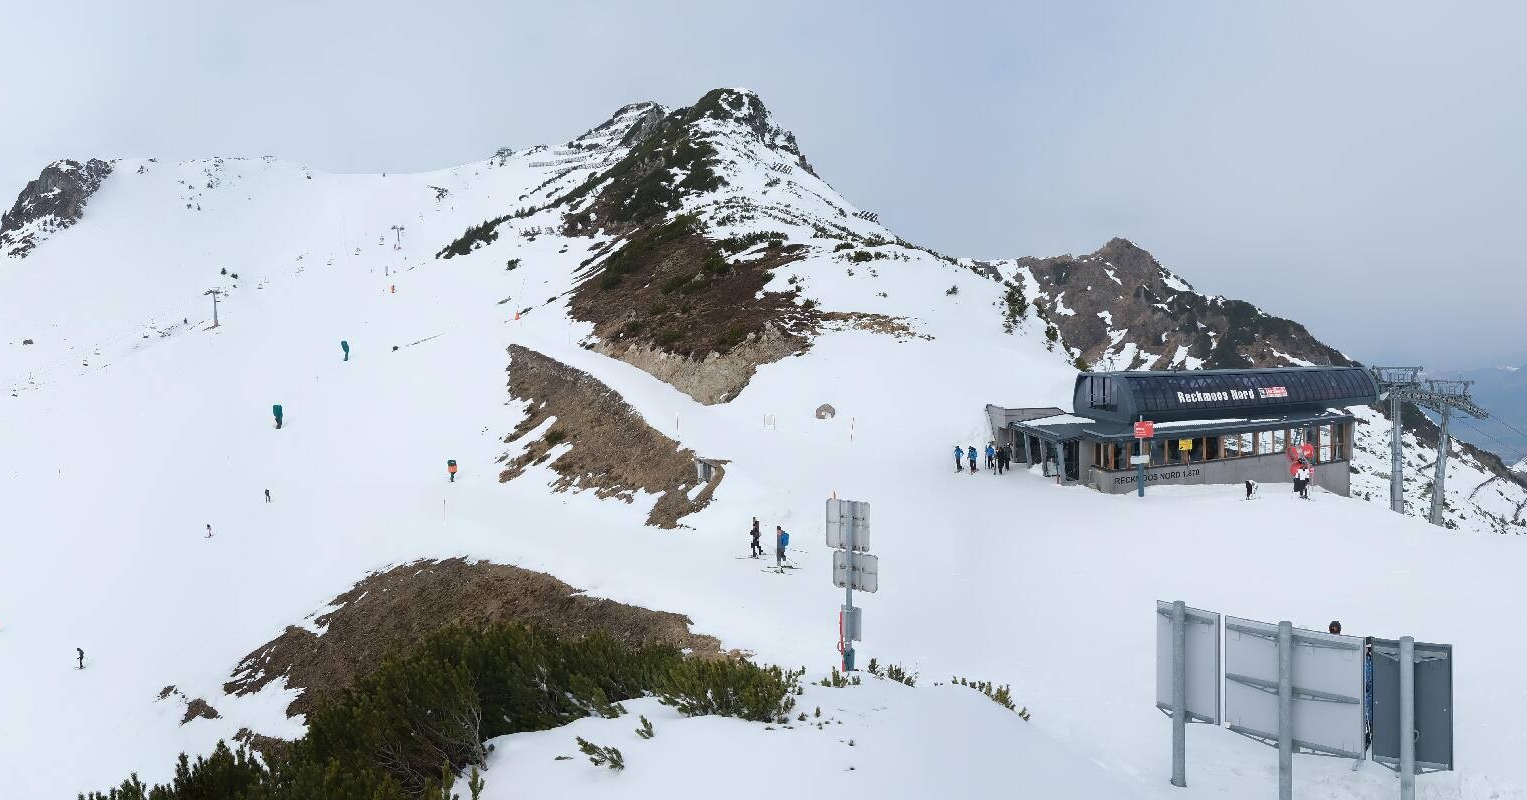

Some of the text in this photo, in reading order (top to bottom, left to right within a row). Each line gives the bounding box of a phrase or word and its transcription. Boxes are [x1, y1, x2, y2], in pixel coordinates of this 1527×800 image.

[1177, 390, 1229, 403] Reckmoos
[1230, 389, 1255, 401] Nord
[1160, 471, 1181, 480] NORD
